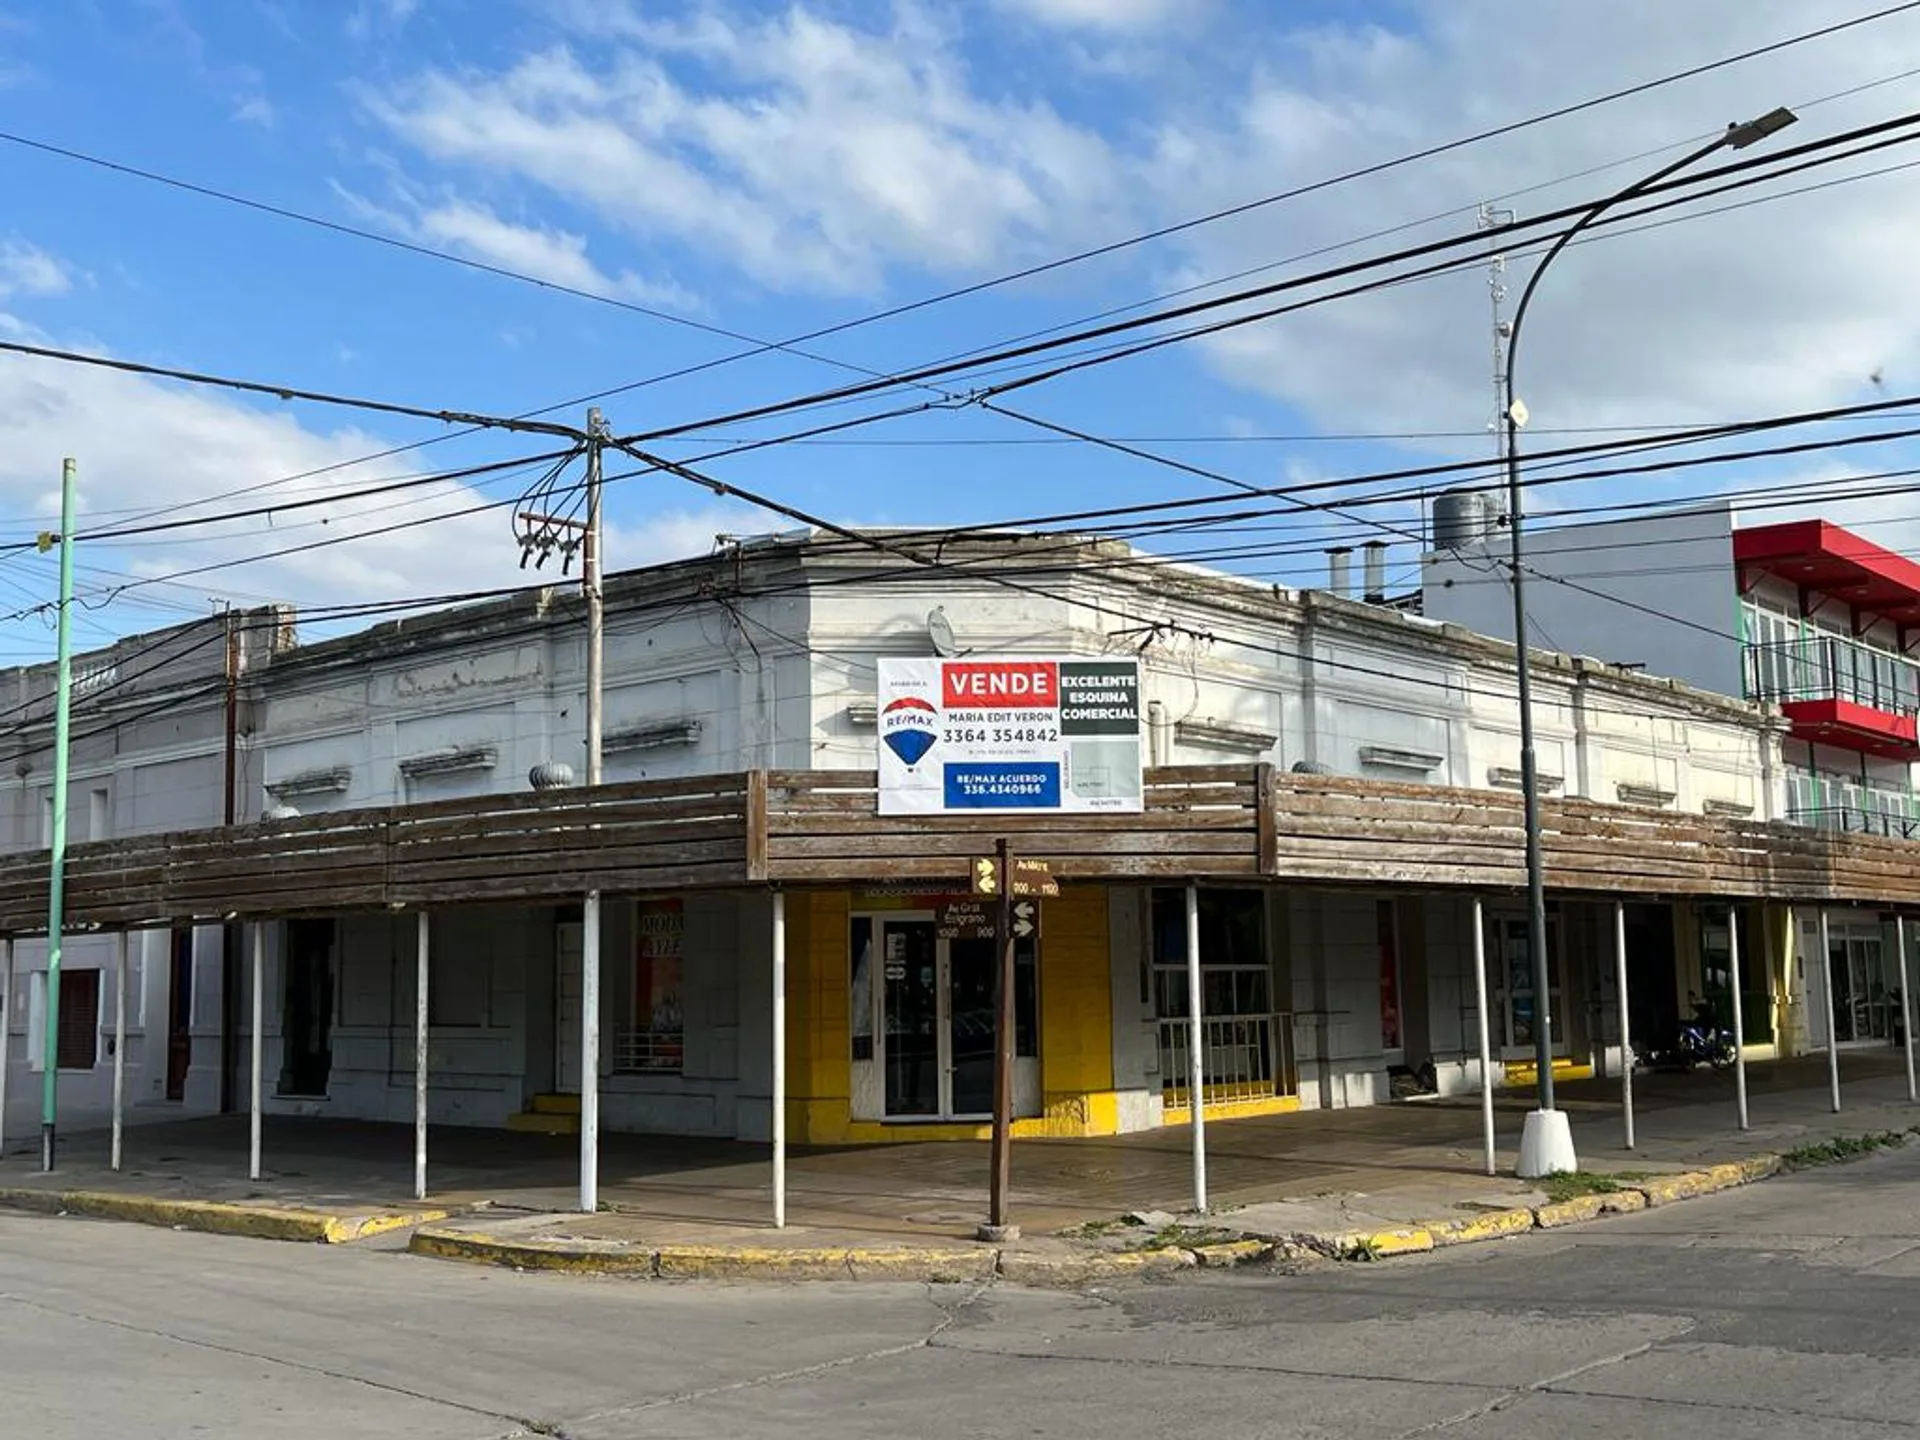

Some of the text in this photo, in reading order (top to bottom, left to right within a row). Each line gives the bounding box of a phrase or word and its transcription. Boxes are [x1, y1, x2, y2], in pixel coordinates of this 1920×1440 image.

[950, 672, 1048, 695] VENDE
[1061, 675, 1136, 688] EXCELENTE
[1069, 691, 1129, 704] ESQUINA
[949, 712, 1053, 723] MARIA EDIT VERON
[1061, 708, 1138, 720] COMERCIAL
[887, 715, 934, 728] RE/MAX
[943, 729, 1058, 743] 3364 354842
[956, 774, 1047, 784] RE/MAX ACUERDO
